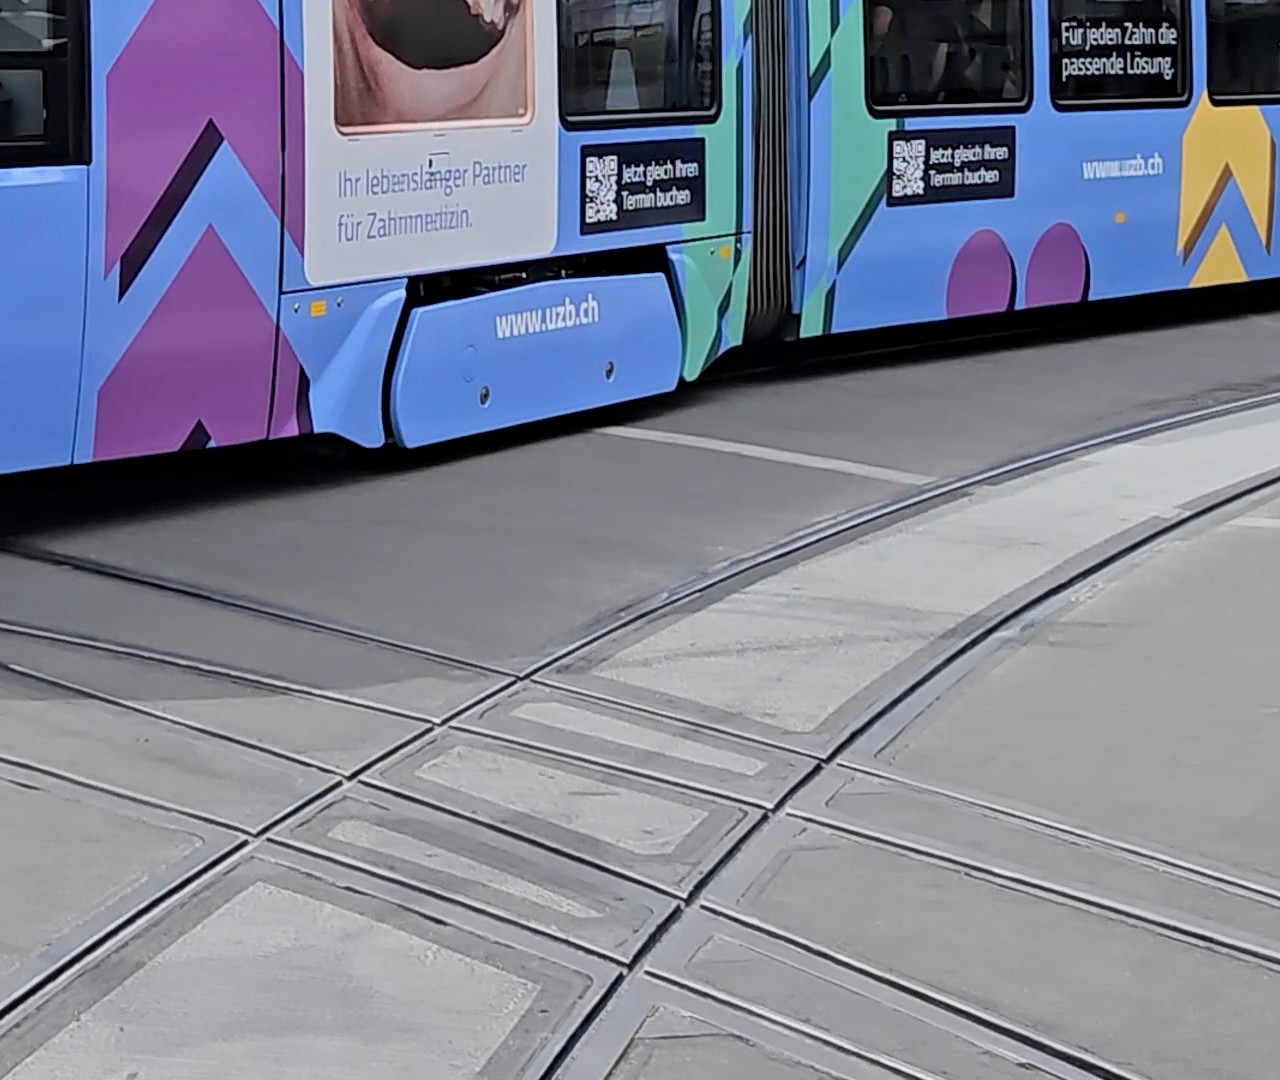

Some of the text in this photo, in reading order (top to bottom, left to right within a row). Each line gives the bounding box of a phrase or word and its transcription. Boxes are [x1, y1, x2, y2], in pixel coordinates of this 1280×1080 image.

[1061, 21, 1177, 50] Für jeden Zahn die
[1062, 50, 1175, 81] passende Lösung.
[929, 143, 1009, 167] Jetzt gleich Ihren
[338, 170, 361, 198] Ihr
[472, 161, 527, 187] Partner
[621, 159, 699, 186] Jetzt gleich Ihren
[928, 166, 999, 187] Termin buchen
[621, 185, 691, 210] Termin buchen
[338, 214, 362, 243] für
[496, 293, 599, 339] www.uzb.ch
